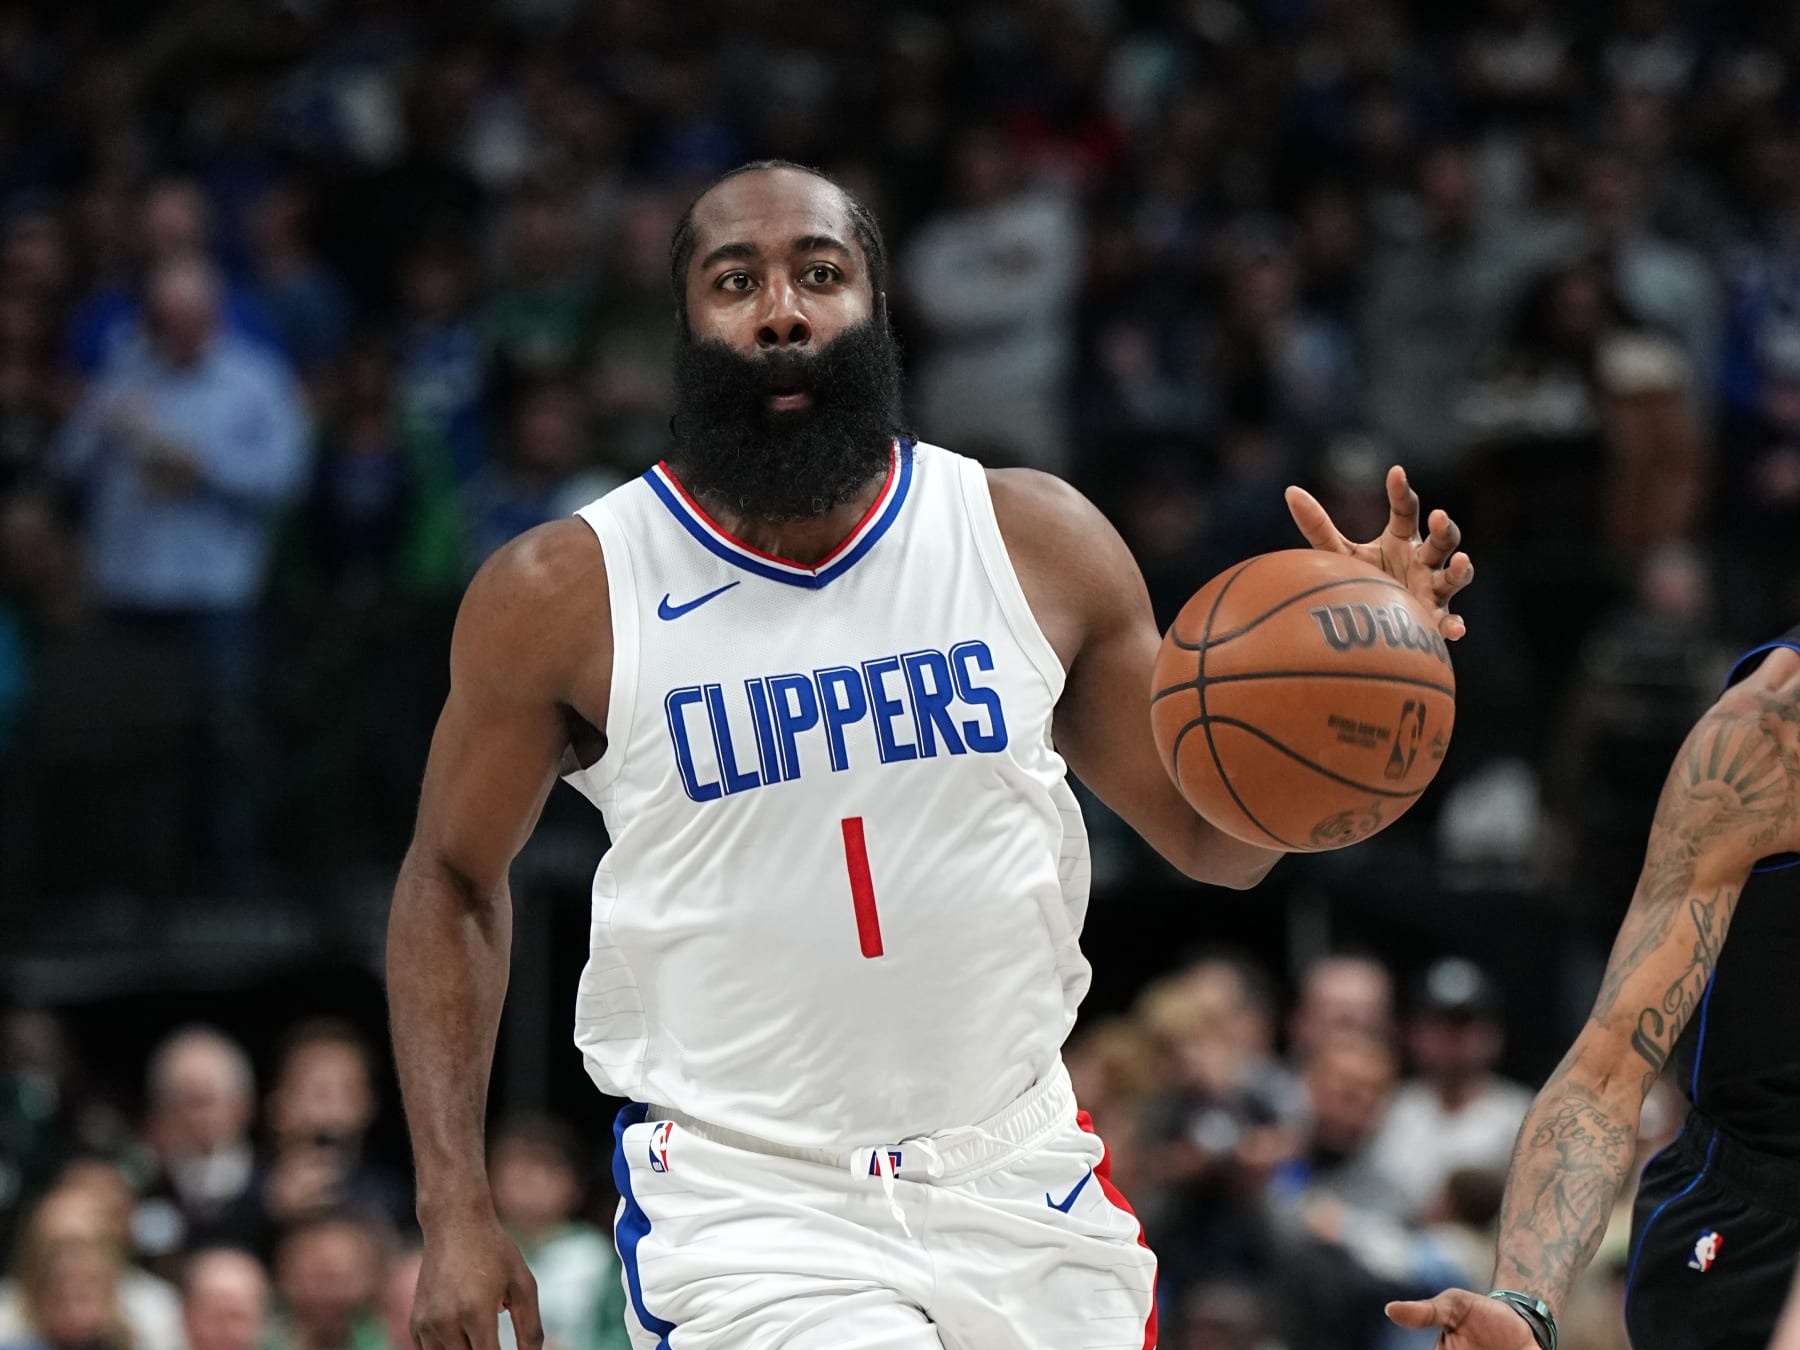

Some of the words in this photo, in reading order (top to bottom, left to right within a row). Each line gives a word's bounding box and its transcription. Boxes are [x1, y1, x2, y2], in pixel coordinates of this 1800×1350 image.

[1310, 603, 1453, 669] Wilso
[664, 639, 1008, 802] CLIPPERS
[841, 816, 884, 959] 1
